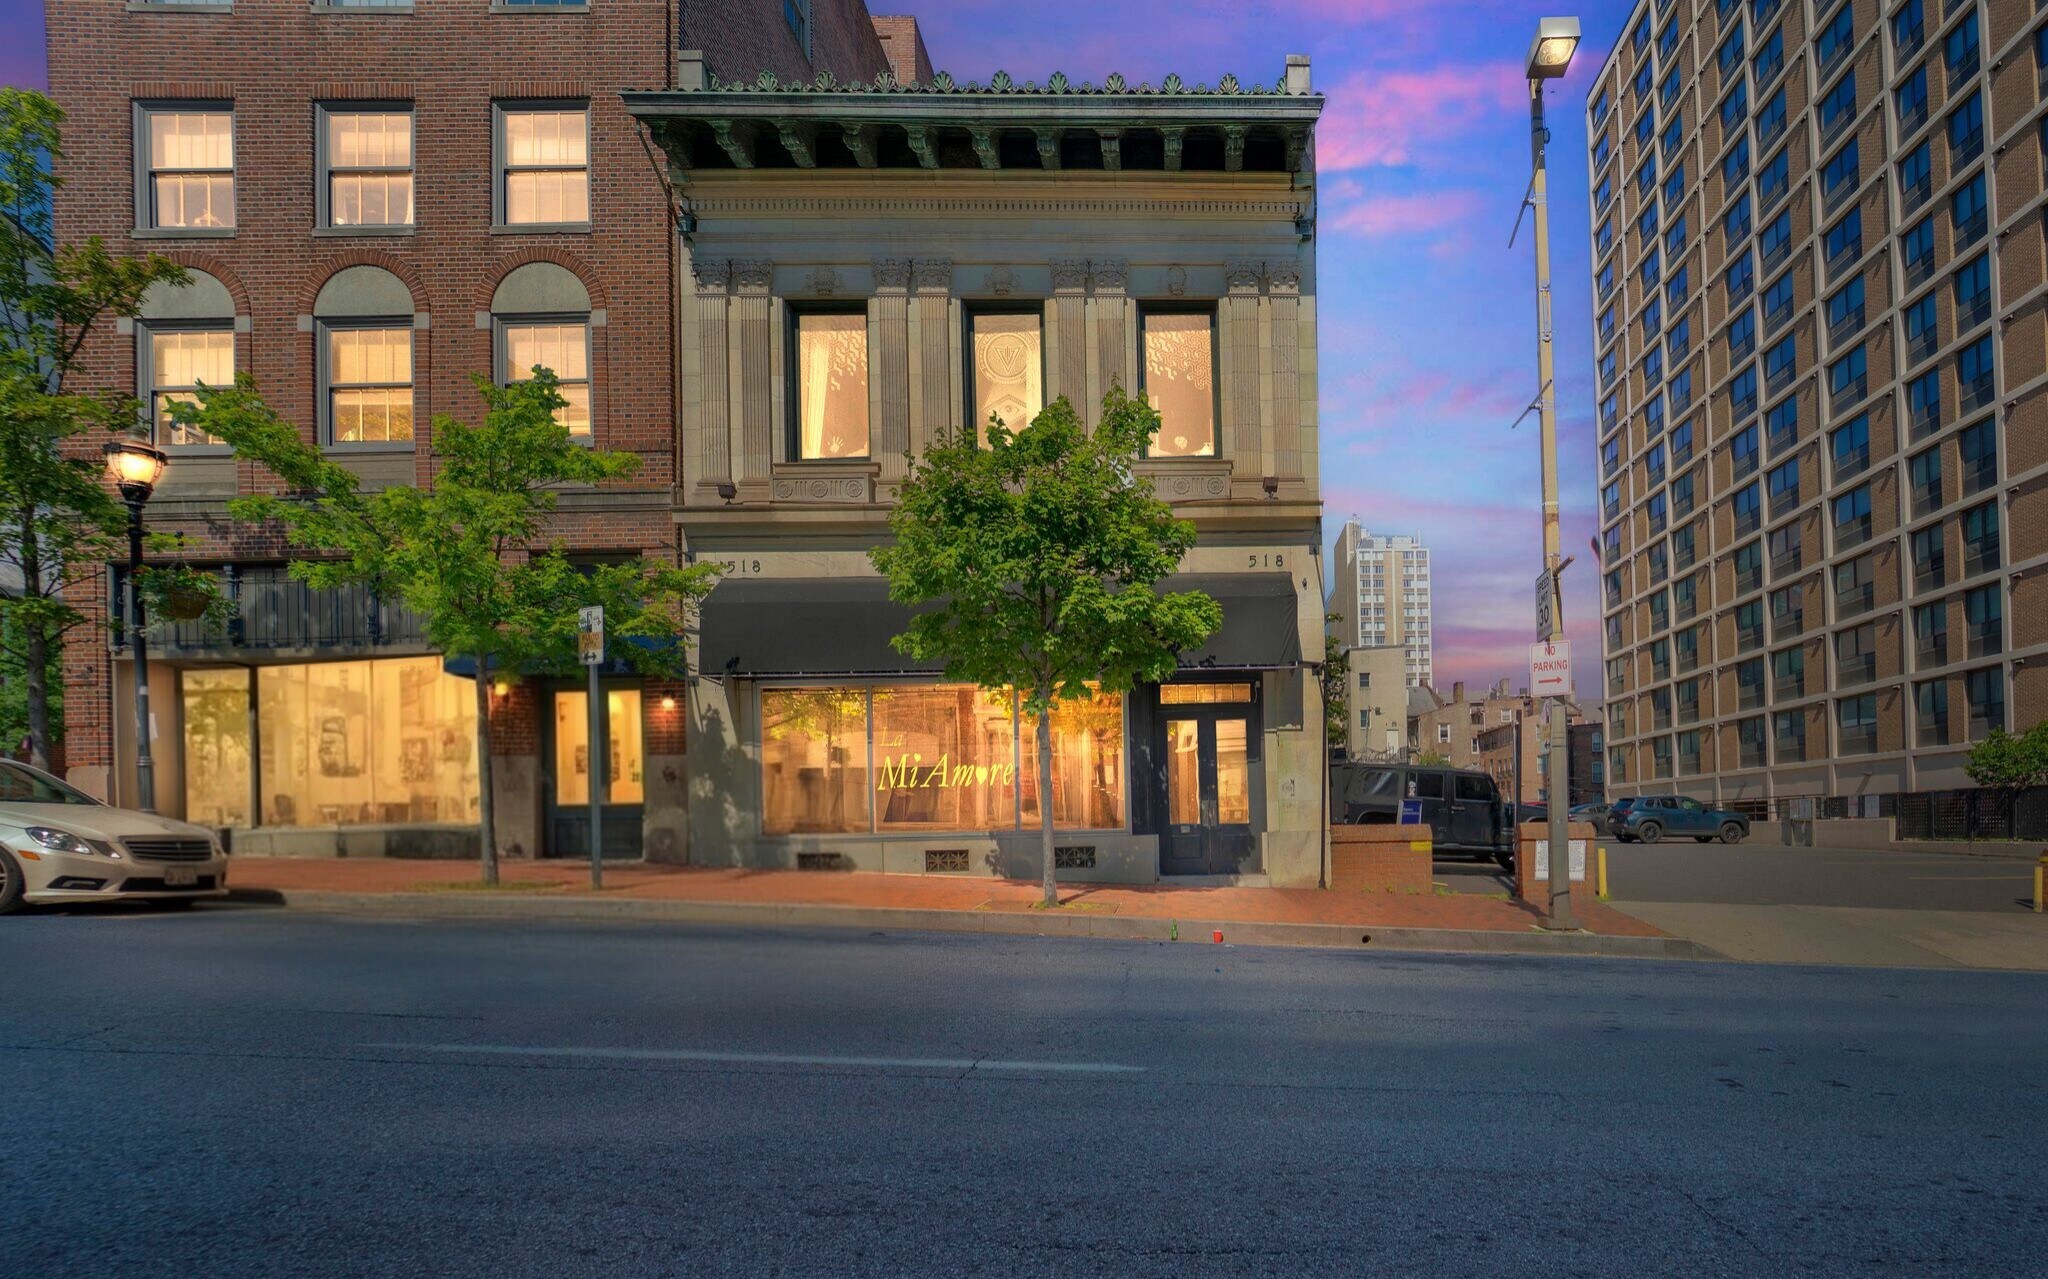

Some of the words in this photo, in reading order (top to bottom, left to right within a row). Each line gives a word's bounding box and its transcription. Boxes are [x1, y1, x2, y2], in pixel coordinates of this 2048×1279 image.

[727, 559, 761, 574] 518
[1249, 553, 1284, 568] 518
[1539, 604, 1550, 627] 30
[1545, 646, 1556, 656] NO
[1533, 660, 1568, 673] PARKING
[880, 726, 903, 747] La
[877, 752, 921, 791] Mi
